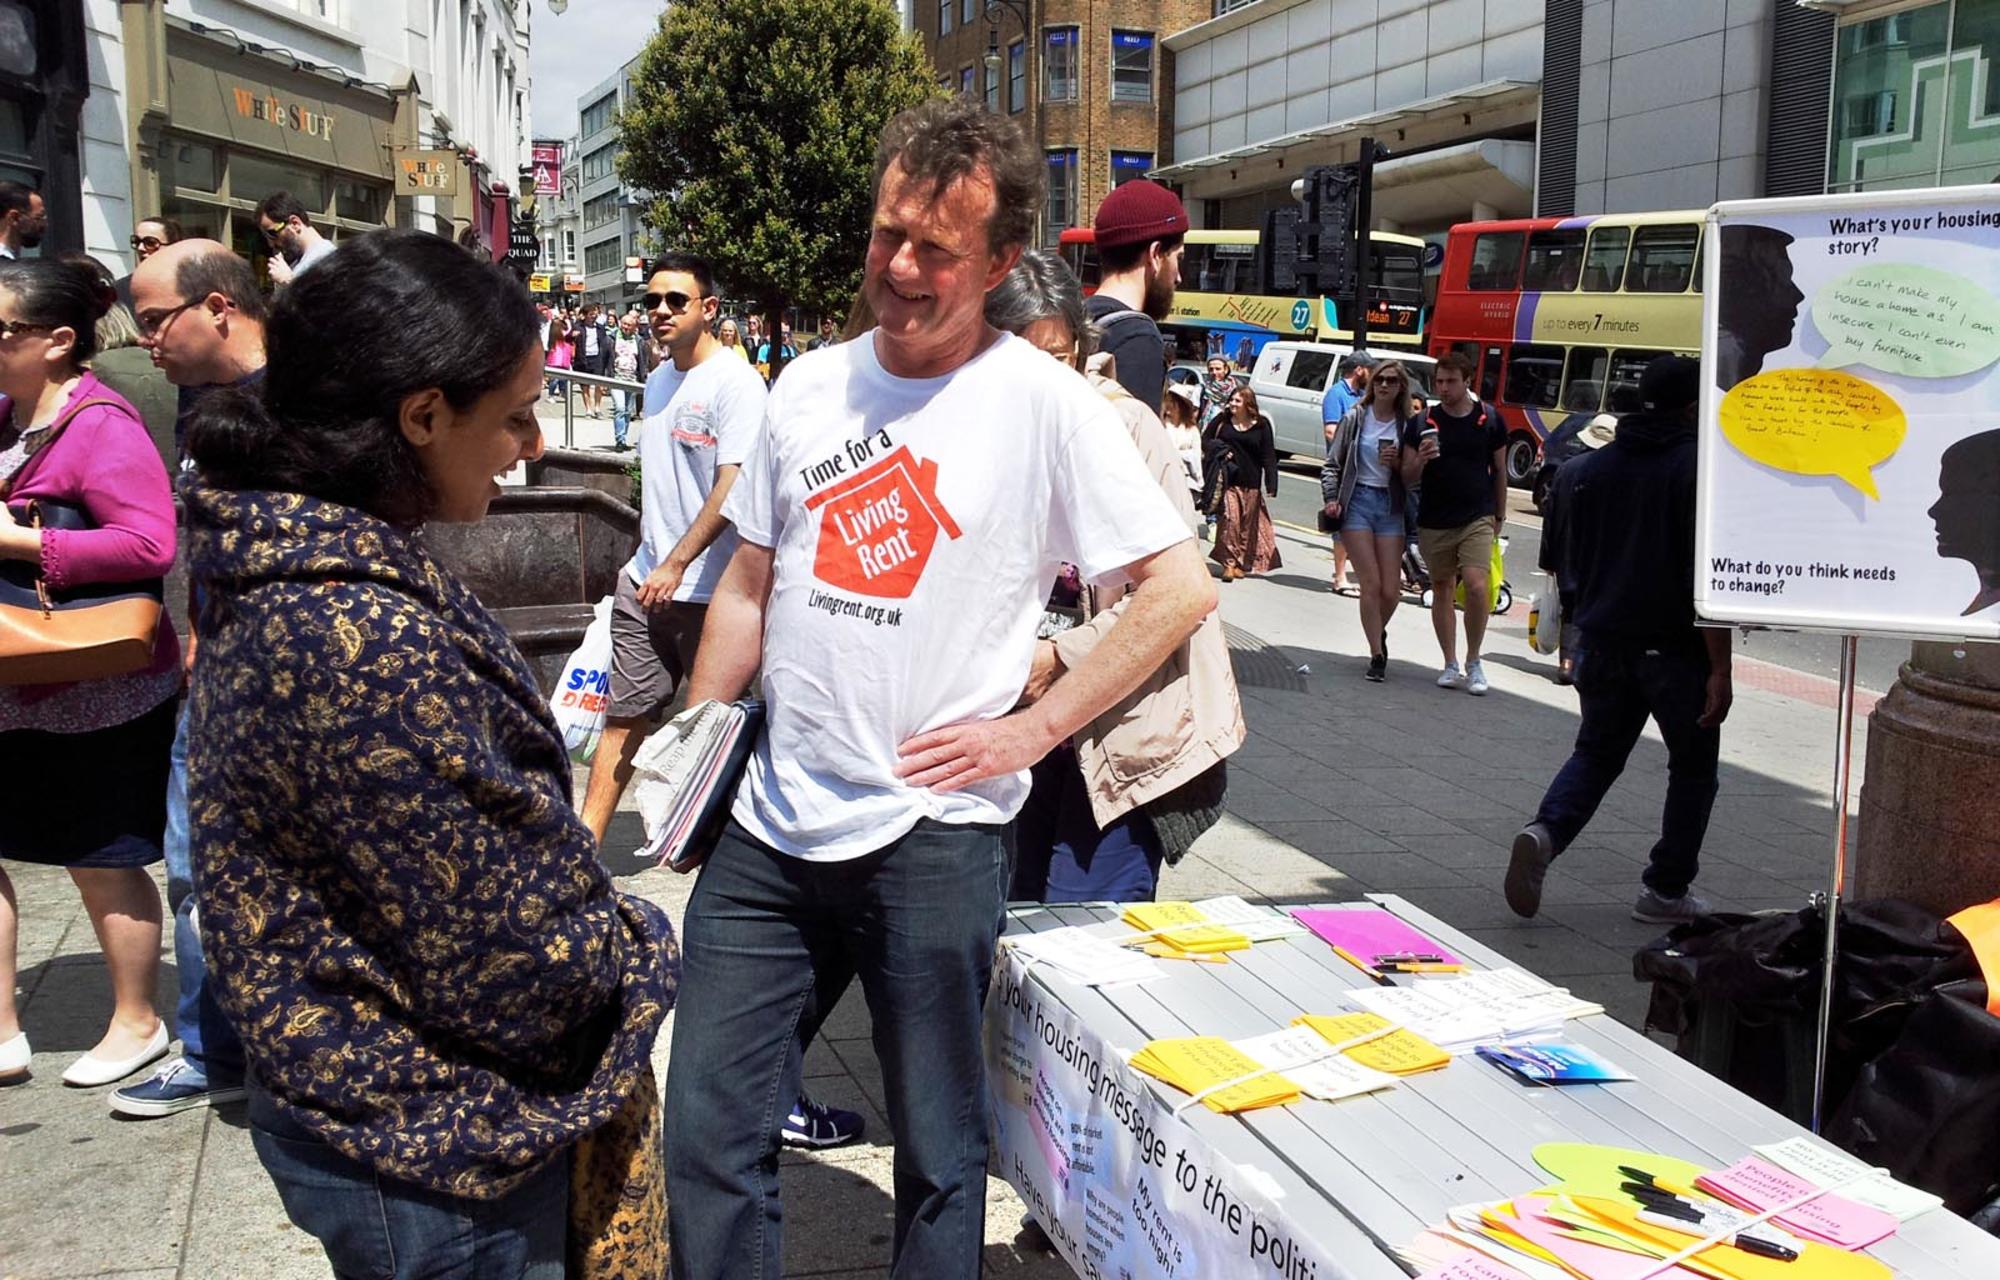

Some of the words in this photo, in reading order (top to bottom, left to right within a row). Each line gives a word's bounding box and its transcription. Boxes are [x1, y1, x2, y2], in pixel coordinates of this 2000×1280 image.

[289, 103, 335, 142] STUFF
[408, 172, 450, 190] STUFF
[1829, 217, 1887, 236] What's
[1891, 217, 1933, 235] your
[1937, 210, 2000, 229] housing
[507, 246, 538, 258] QUAD
[511, 234, 533, 245] THE
[1828, 236, 1880, 256] story?
[1855, 279, 1894, 290] can't
[1897, 285, 1930, 300] make
[1293, 305, 1309, 325] 27
[1398, 310, 1411, 326] 27
[1480, 302, 1511, 311] ELECTRIC
[1484, 311, 1510, 319] HYBRID
[1834, 290, 1871, 308] house
[1876, 301, 1885, 310] a
[1888, 301, 1920, 317] home
[1926, 311, 1945, 323] as
[1971, 322, 1995, 335] am
[1542, 319, 1554, 331] up
[1556, 318, 1568, 330] to
[1568, 318, 1592, 334] every
[1592, 313, 1603, 331] 7
[1602, 318, 1640, 333] minutes
[1844, 334, 1864, 351] buy
[1873, 338, 1923, 363] furniture
[1897, 327, 1930, 341] can't
[1934, 337, 1966, 350] even
[799, 453, 847, 491] Time
[845, 434, 875, 469] for
[880, 428, 893, 449] a
[833, 486, 909, 547] Living
[855, 526, 918, 581] Rent
[1711, 557, 1752, 573] What
[1755, 560, 1772, 576] do
[1774, 563, 1803, 579] you
[1808, 561, 1850, 580] think
[1853, 565, 1896, 582] needs
[1711, 576, 1726, 591] to
[1728, 576, 1786, 596] change?
[808, 588, 904, 627] Livingrent.org.uk
[1004, 976, 1033, 1024] your
[1034, 1002, 1100, 1095] housing
[1099, 1073, 1167, 1169] message
[1176, 1148, 1198, 1193] to
[1203, 1174, 1243, 1236] the
[1723, 1174, 1779, 1202] denied
[1745, 1163, 1797, 1192] People
[1015, 1151, 1046, 1216] Have
[1048, 1207, 1078, 1260] your
[1137, 1176, 1153, 1210] My
[1152, 1211, 1173, 1246] rent
[1172, 1241, 1183, 1264] is
[1131, 1198, 1148, 1232] too
[1148, 1229, 1175, 1279] high!
